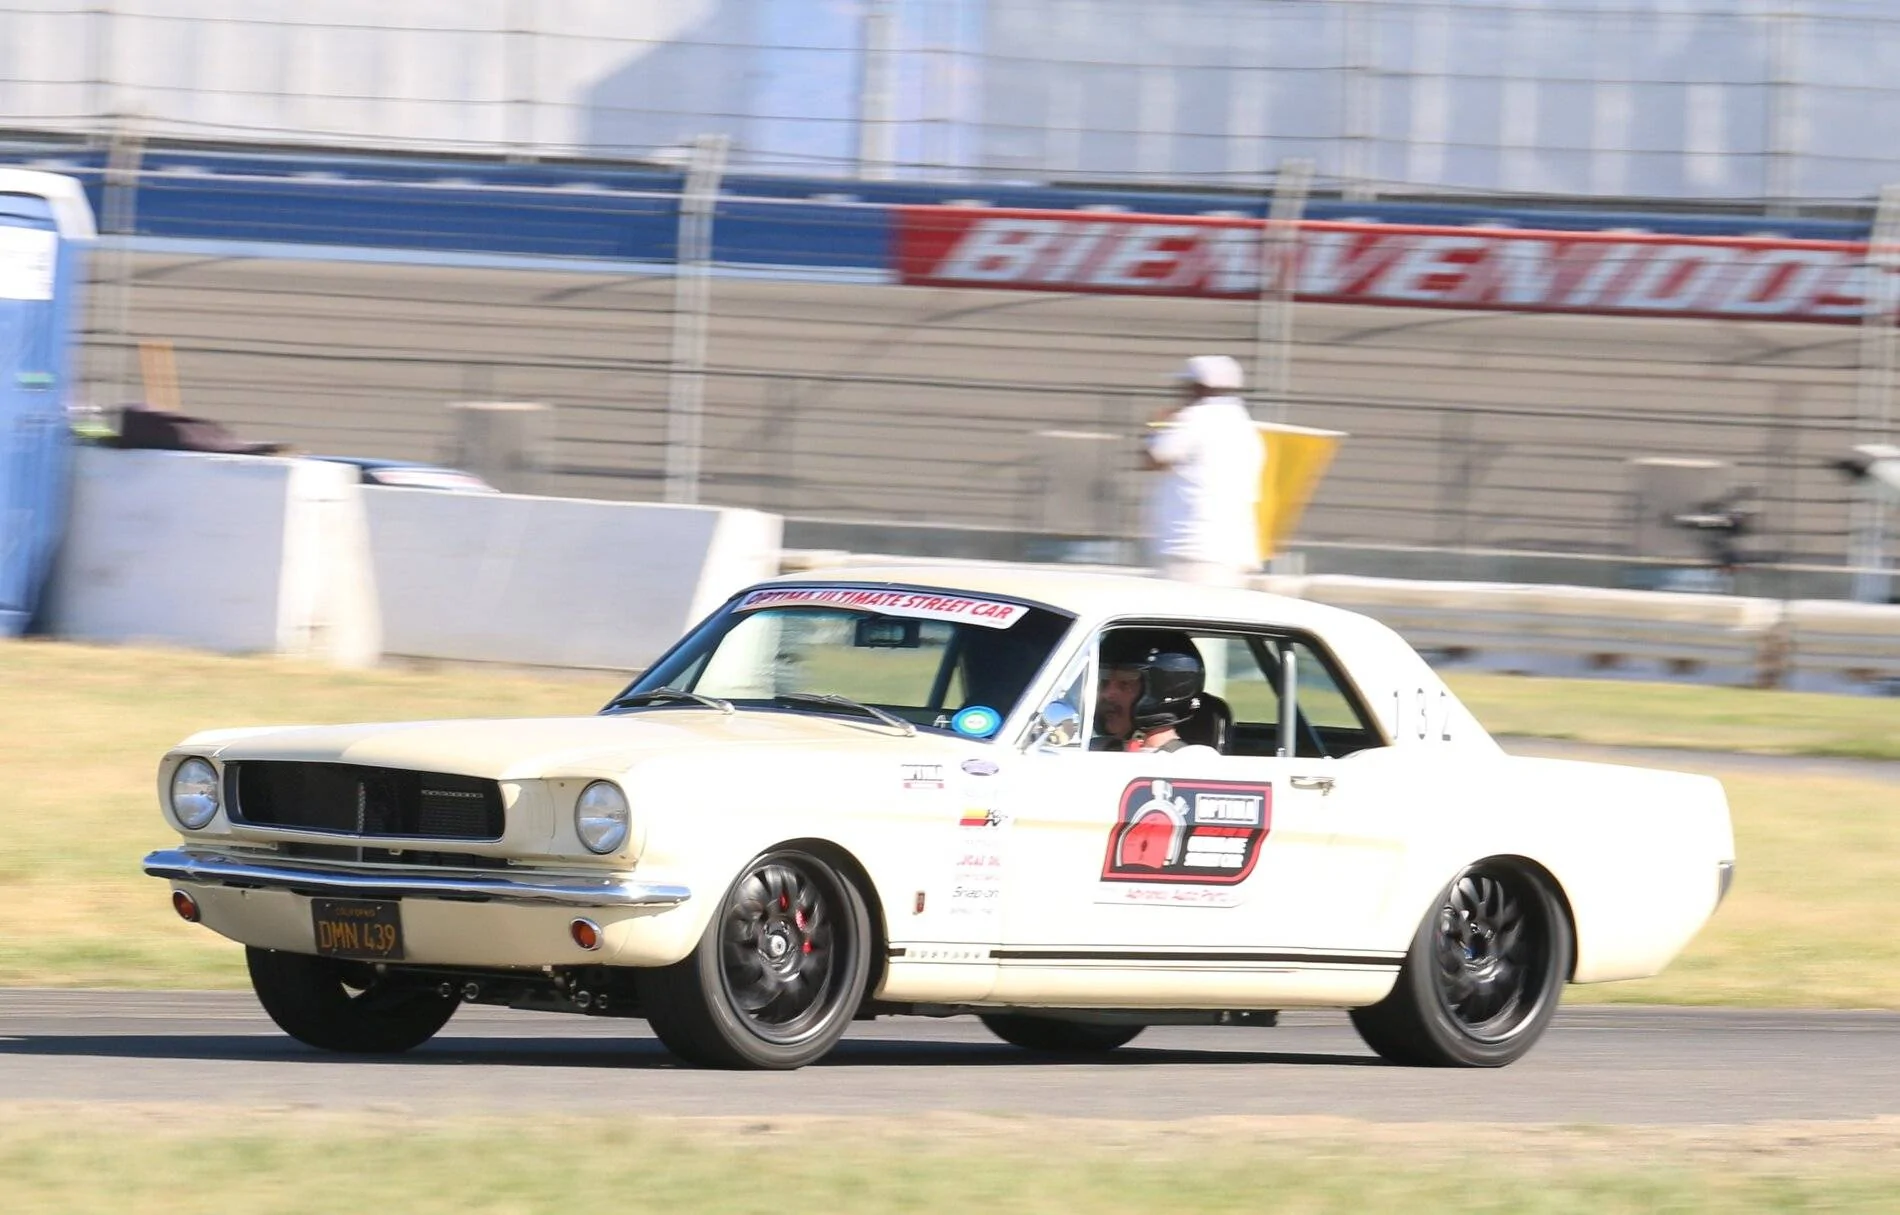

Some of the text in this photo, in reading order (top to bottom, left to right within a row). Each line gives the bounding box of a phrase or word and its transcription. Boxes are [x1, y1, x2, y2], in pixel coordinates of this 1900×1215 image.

[930, 216, 1900, 319] BIENVENIDOS
[744, 590, 1016, 620] OPTIMA ULTIMATE STREET CAR
[952, 886, 1000, 898] Snap-on
[318, 920, 396, 951] DMN 439
